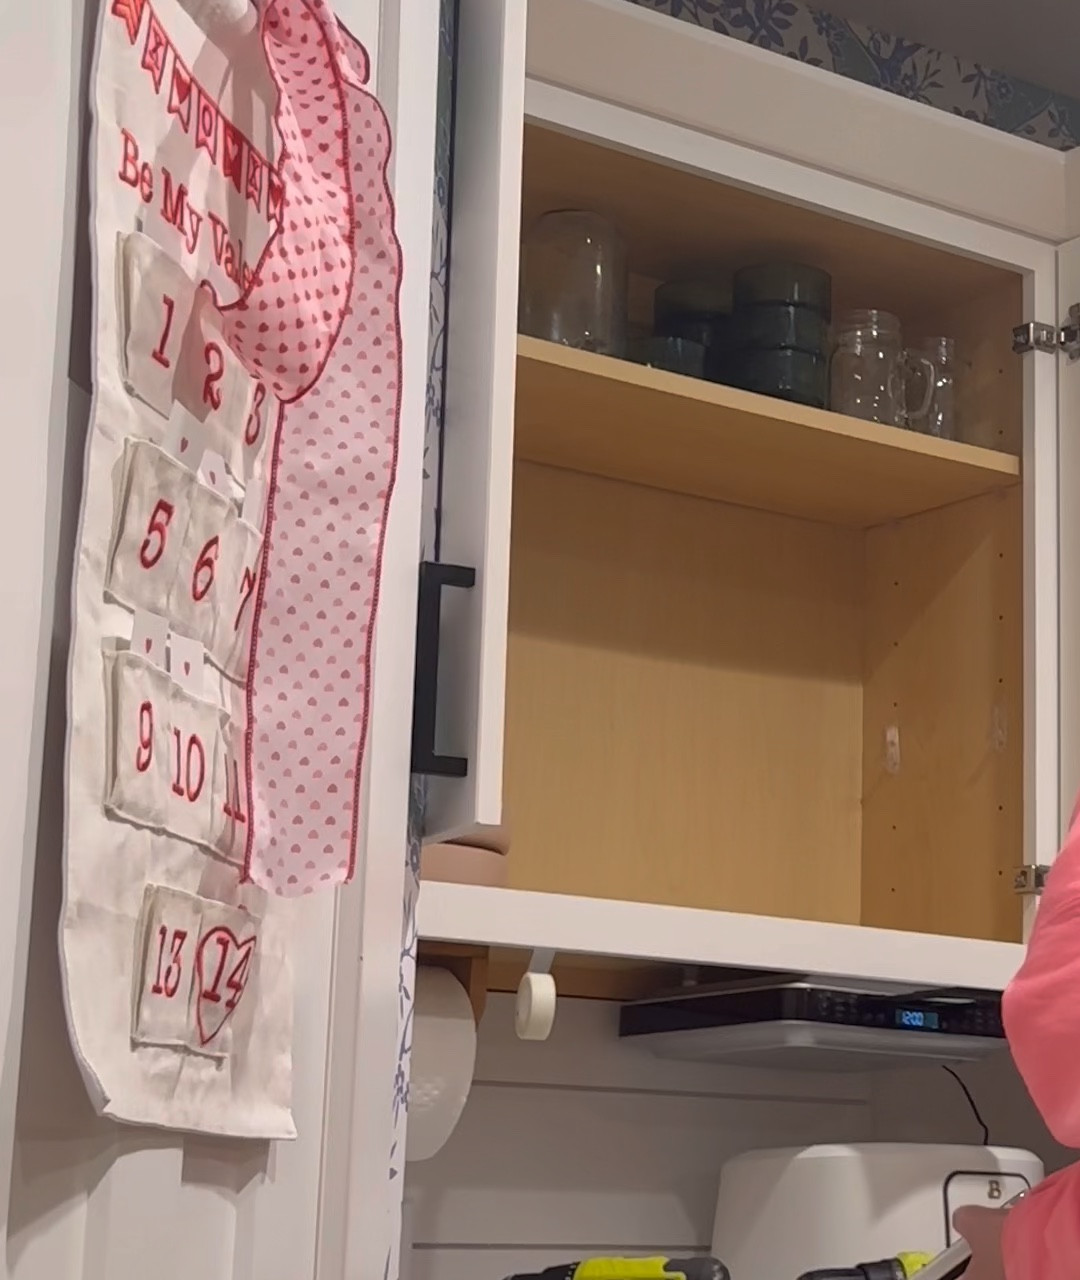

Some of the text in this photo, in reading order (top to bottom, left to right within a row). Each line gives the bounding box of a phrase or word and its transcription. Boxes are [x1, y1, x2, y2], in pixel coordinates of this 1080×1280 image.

[118, 127, 154, 204] Be
[160, 166, 204, 255] My
[152, 293, 267, 447] 1 2 3
[139, 498, 175, 570] 5
[192, 534, 220, 602] 6
[136, 701, 246, 824] 9 10 11
[151, 924, 253, 1010] 13 14
